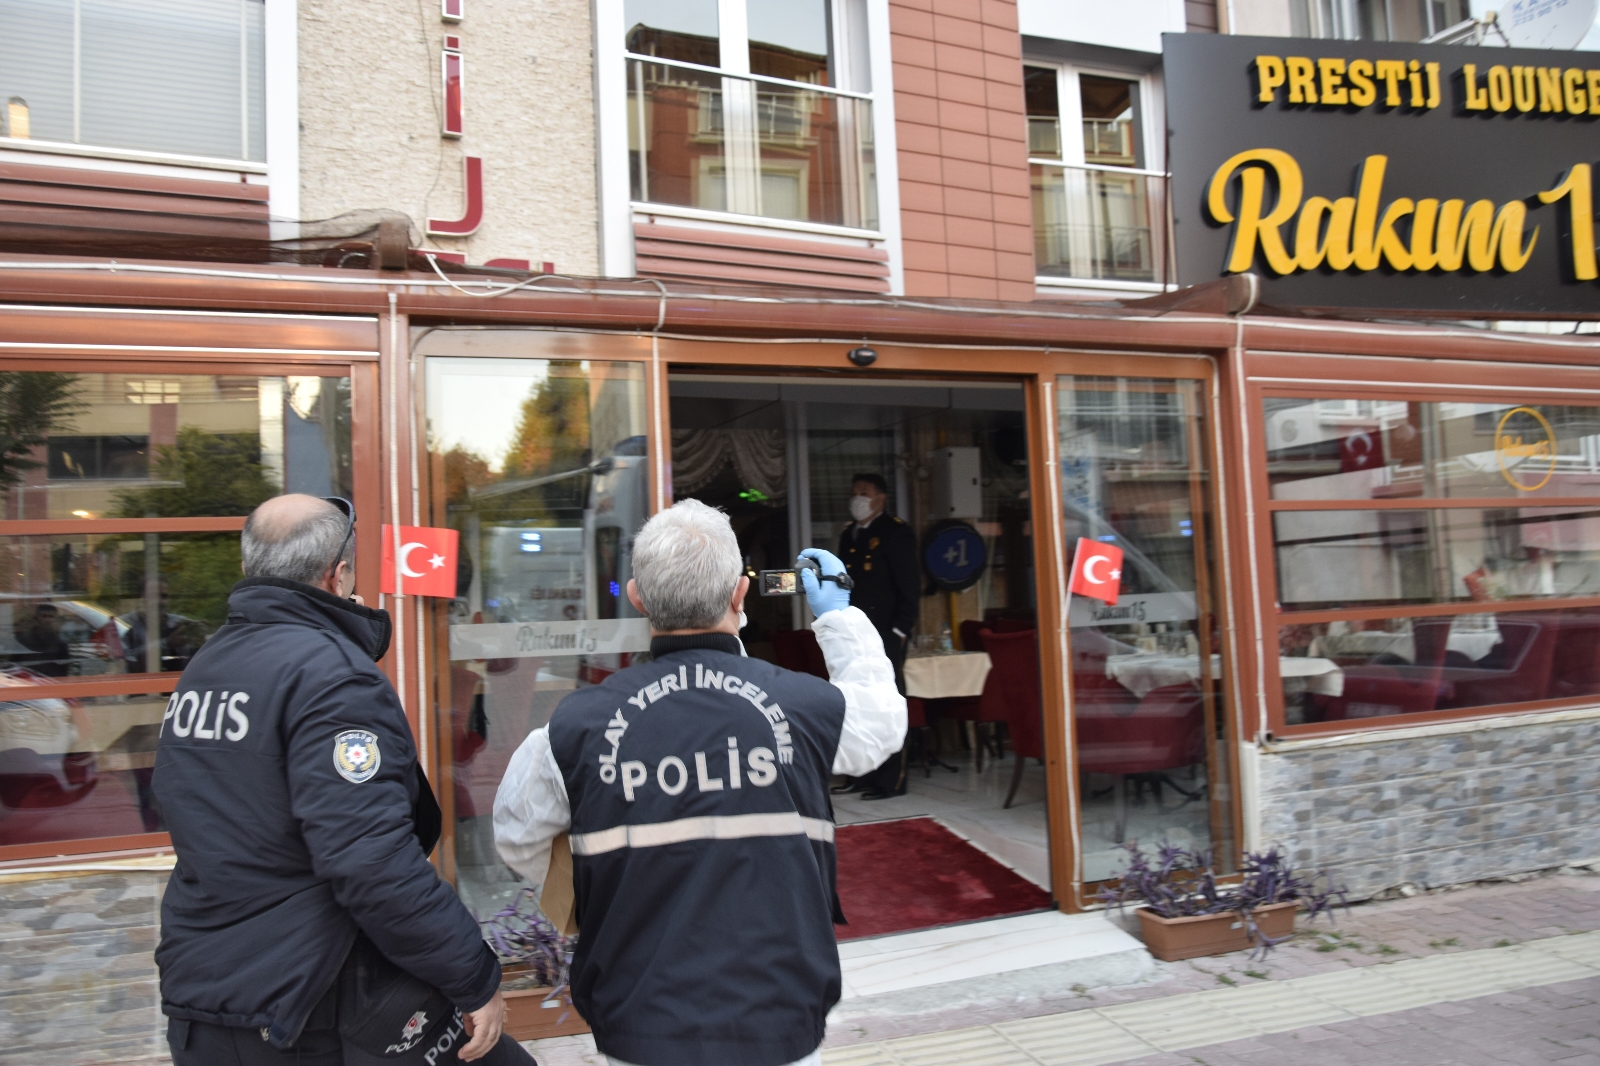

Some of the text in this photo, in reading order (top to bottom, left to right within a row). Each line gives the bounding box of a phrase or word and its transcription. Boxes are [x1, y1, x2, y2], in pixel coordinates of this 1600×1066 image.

[1463, 63, 1600, 115] LOUNGE
[1537, 162, 1600, 281] 1
[598, 663, 794, 785] OLAY YERİ İNCELEME
[620, 735, 778, 803] POLİS
